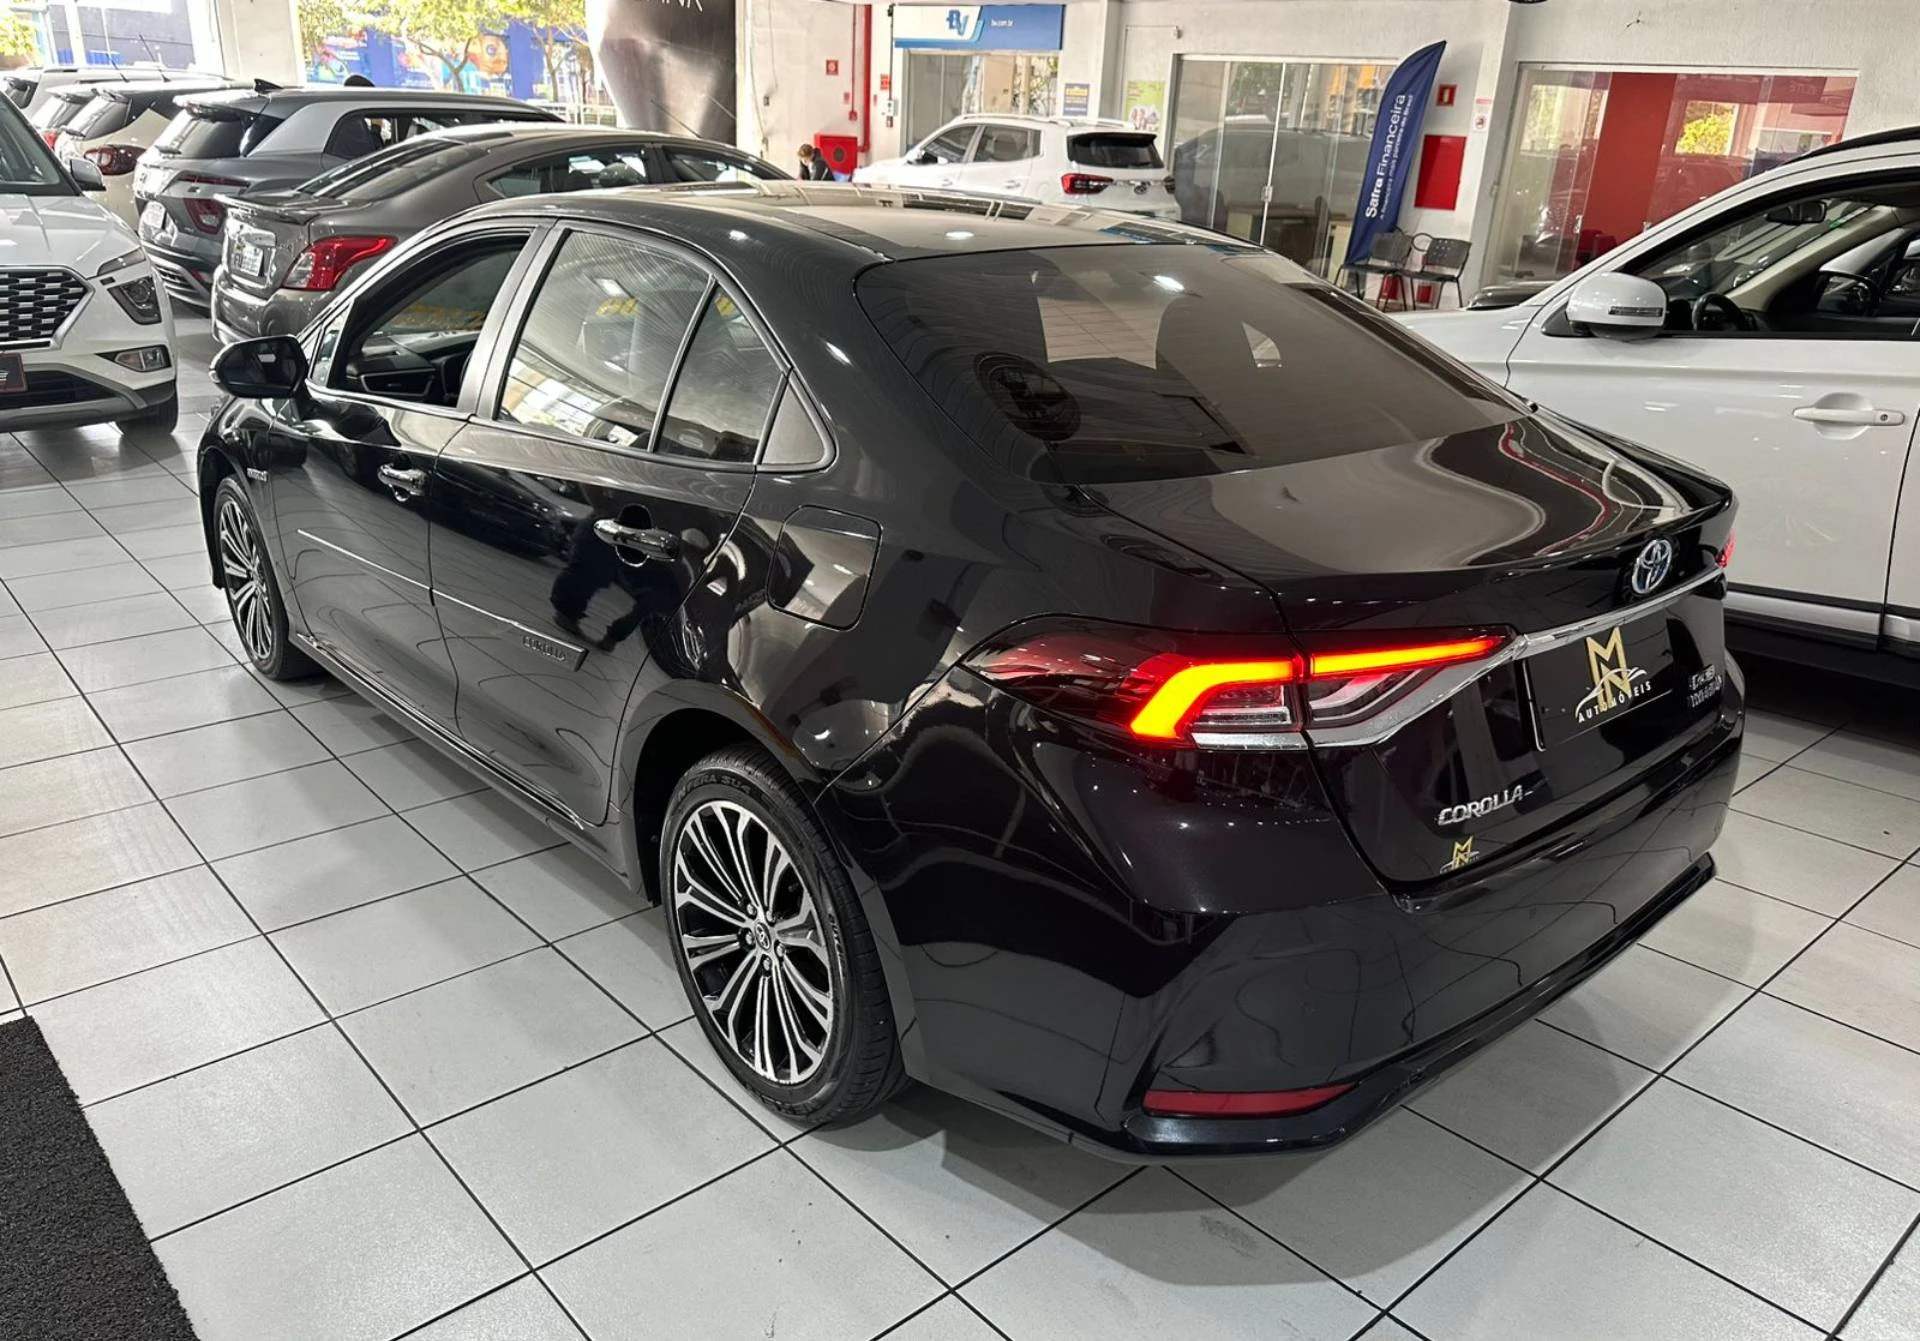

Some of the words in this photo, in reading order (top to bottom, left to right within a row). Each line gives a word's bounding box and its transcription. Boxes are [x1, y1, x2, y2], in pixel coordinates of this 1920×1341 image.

[1365, 177, 1384, 218] Safra
[1376, 94, 1406, 176] Financeira
[1438, 784, 1523, 826] COROLLA
